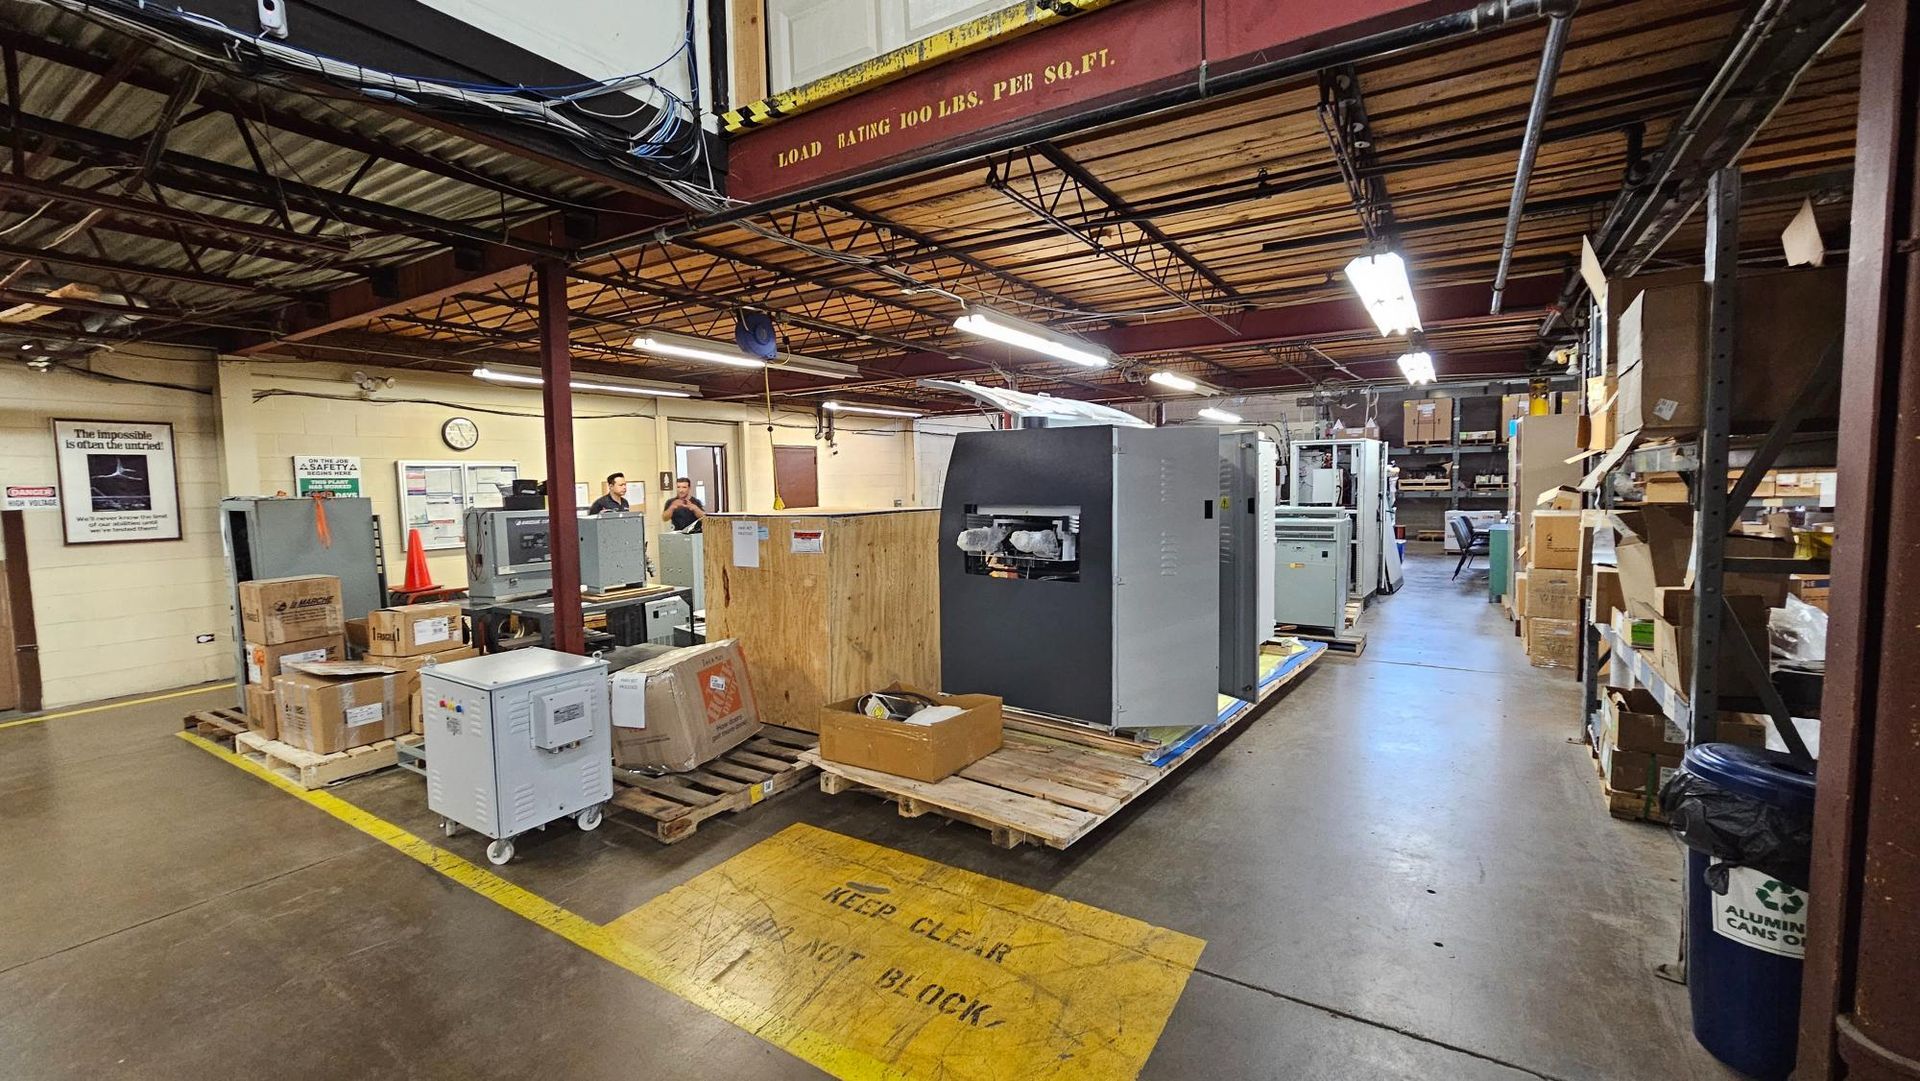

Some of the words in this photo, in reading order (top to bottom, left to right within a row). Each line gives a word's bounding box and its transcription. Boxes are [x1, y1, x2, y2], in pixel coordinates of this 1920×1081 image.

[778, 140, 823, 168] LOAD
[837, 117, 891, 149] RATING
[900, 105, 933, 130] 100
[938, 90, 984, 118] LBS.
[993, 72, 1034, 101] PER
[73, 428, 95, 439] The
[97, 429, 153, 441] impossible
[65, 440, 75, 449] is
[77, 440, 105, 449] often
[106, 439, 123, 449] the
[124, 441, 164, 451] untried!
[309, 463, 349, 471] SAFETY
[11, 488, 53, 497] DANGER
[8, 499, 25, 507] HIGH
[29, 499, 57, 507] VOLTAGE
[299, 595, 335, 608] MARCHE
[822, 886, 897, 918] KEEP
[908, 916, 1012, 964] CLEAR
[1726, 917, 1778, 941] CANS
[799, 937, 866, 965] NOT
